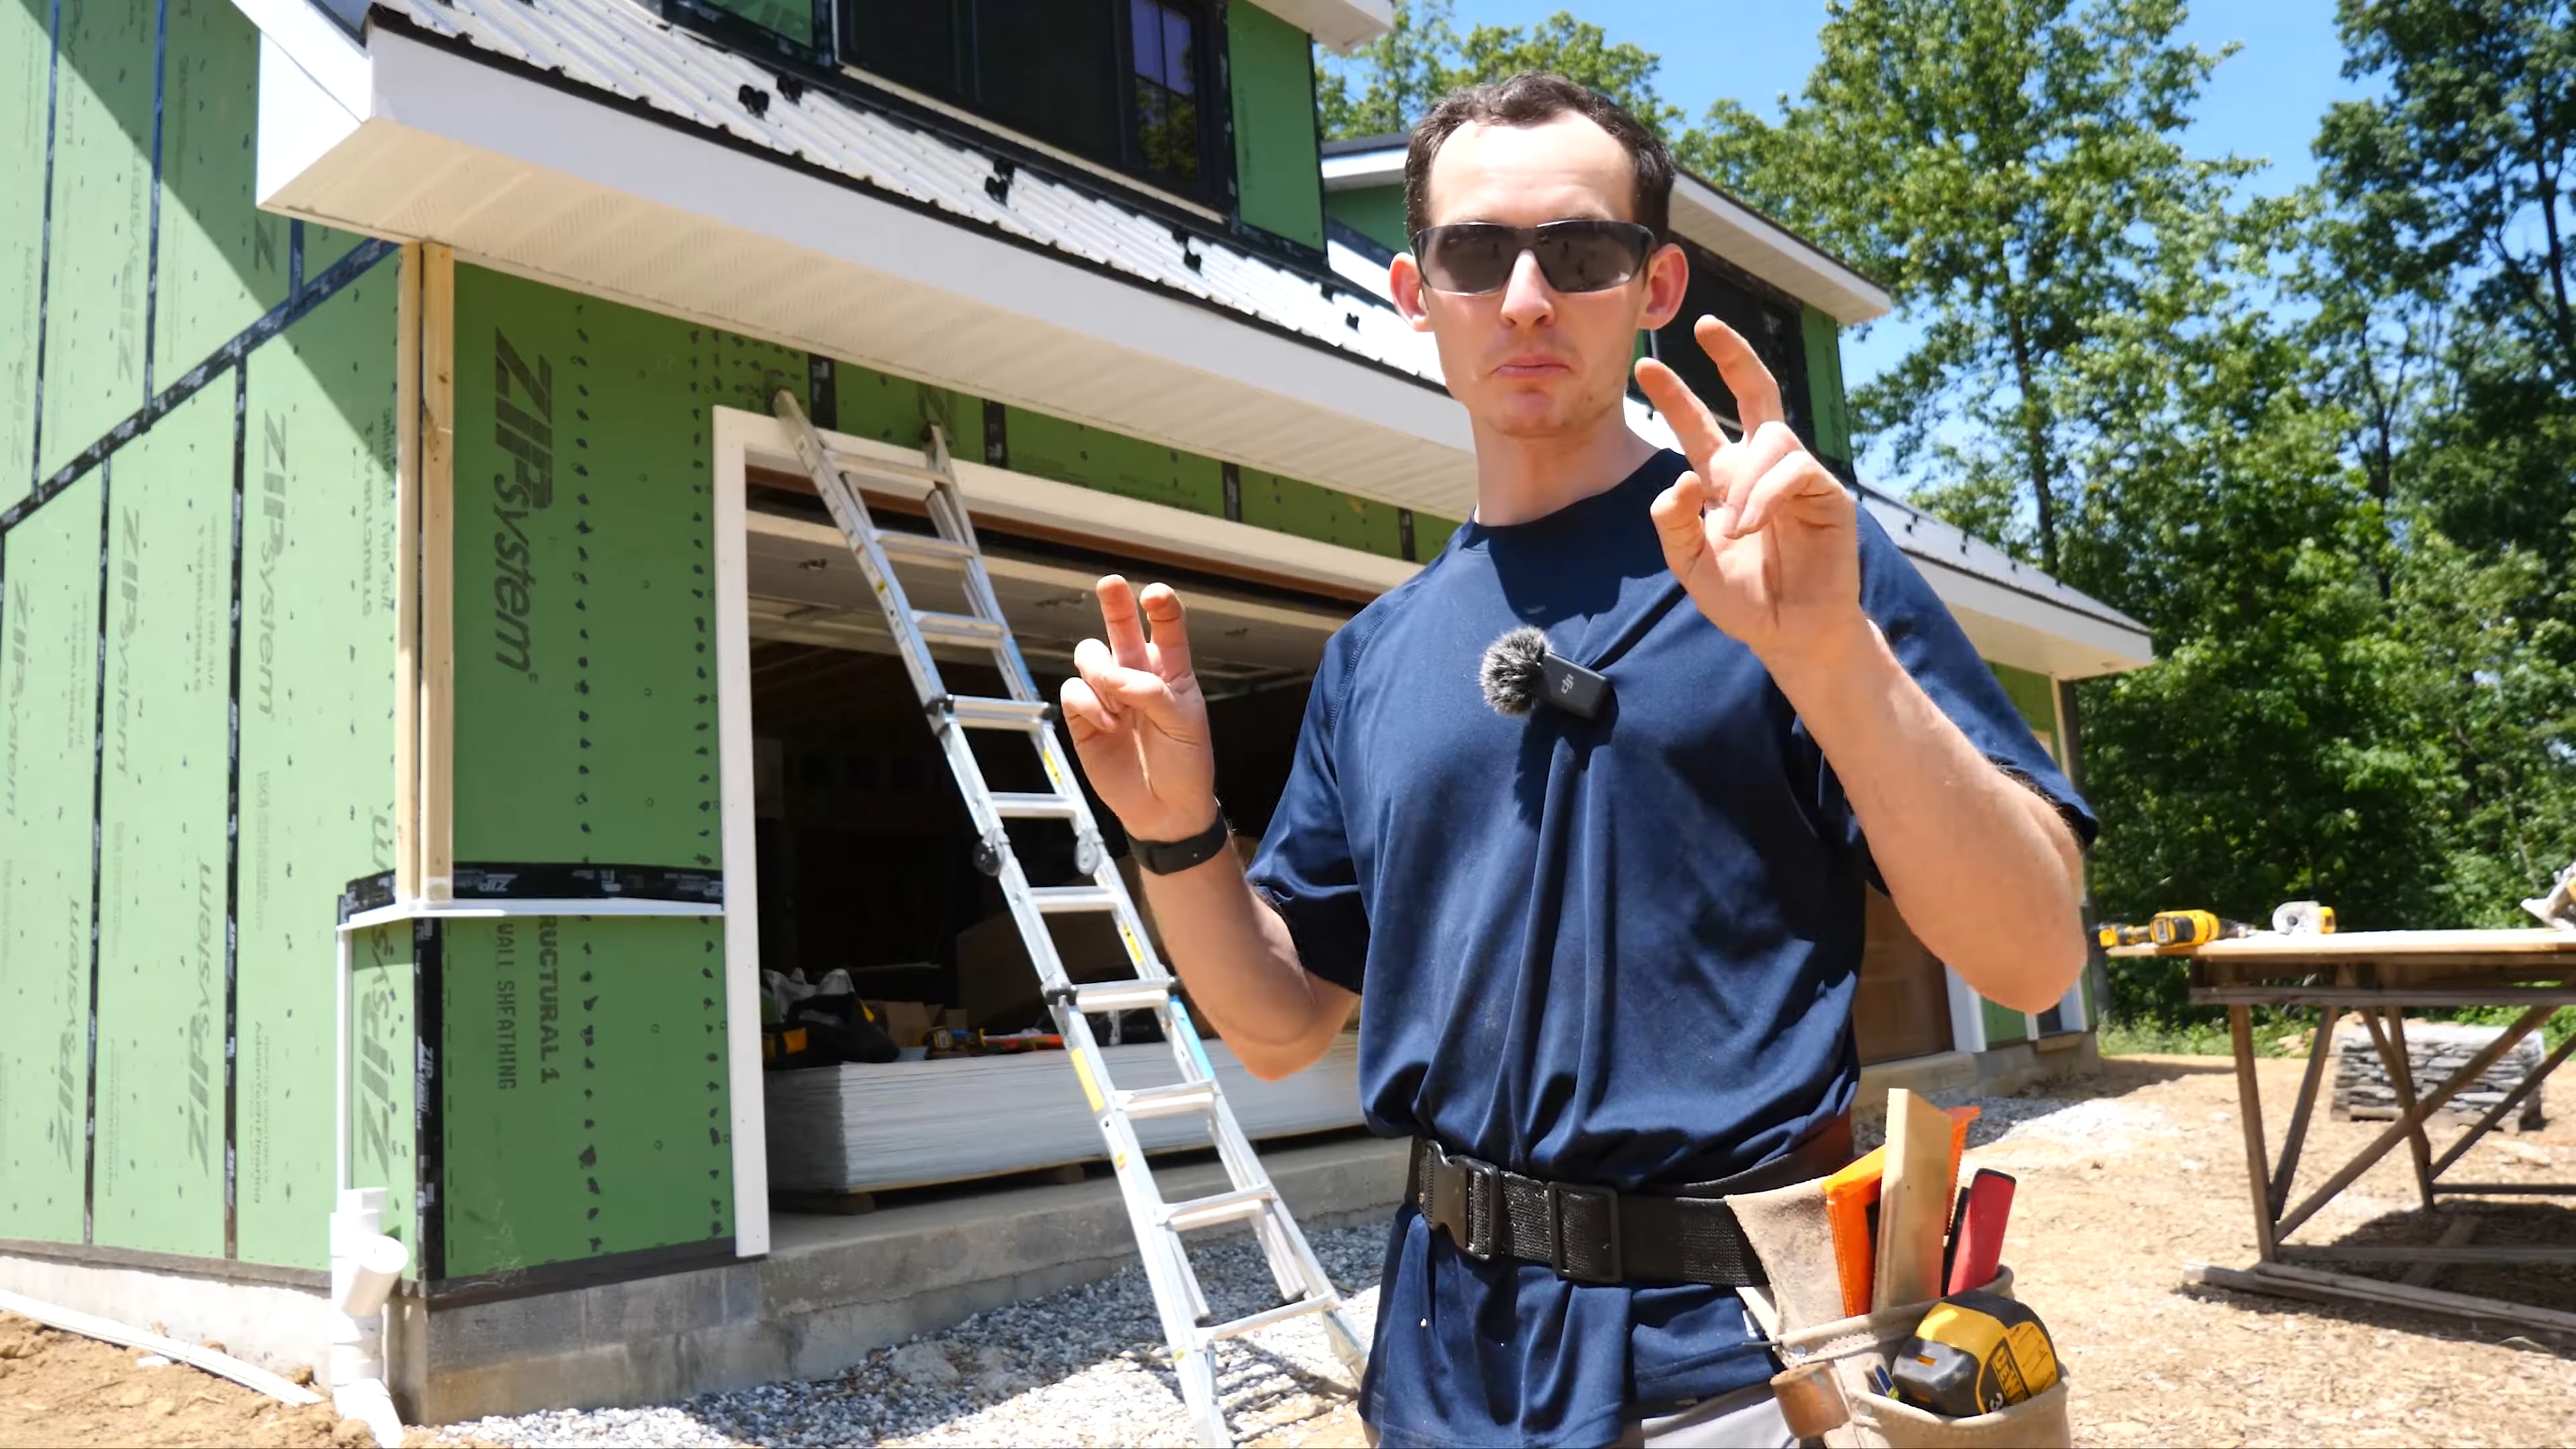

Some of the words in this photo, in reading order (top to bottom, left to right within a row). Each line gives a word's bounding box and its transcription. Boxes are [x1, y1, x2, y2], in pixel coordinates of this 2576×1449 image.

[495, 922, 516, 972] WALL
[539, 916, 561, 1063] RUCTURAL
[496, 979, 518, 1091] SHEATHING
[539, 1067, 560, 1085] 1
